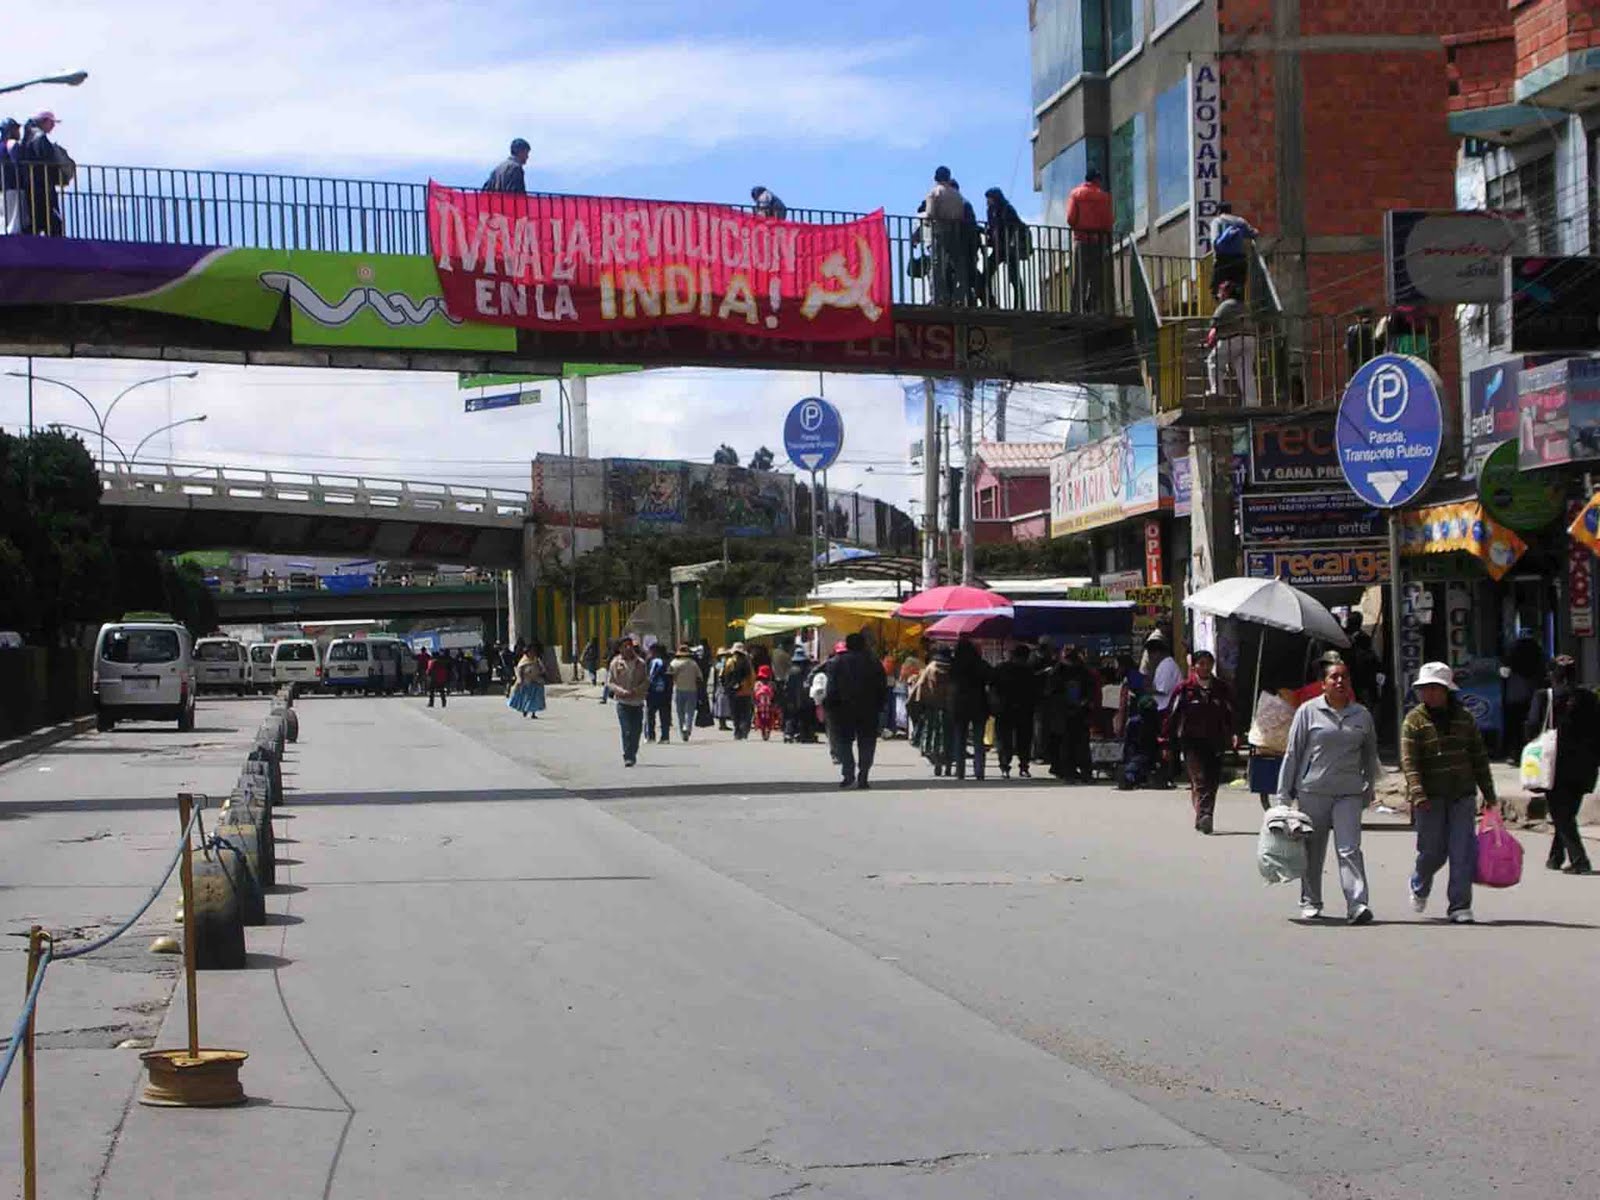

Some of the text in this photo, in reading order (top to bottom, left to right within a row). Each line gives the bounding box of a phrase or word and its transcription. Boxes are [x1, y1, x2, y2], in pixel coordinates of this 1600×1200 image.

[550, 218, 594, 281] LA
[475, 278, 526, 318] EN
[534, 283, 579, 322] LA
[1261, 469, 1271, 479] Y
[1275, 467, 1314, 479] GANA
[1344, 448, 1395, 463] Transporte
[1056, 464, 1107, 518] FARMACIA
[1275, 551, 1391, 582] recarga
